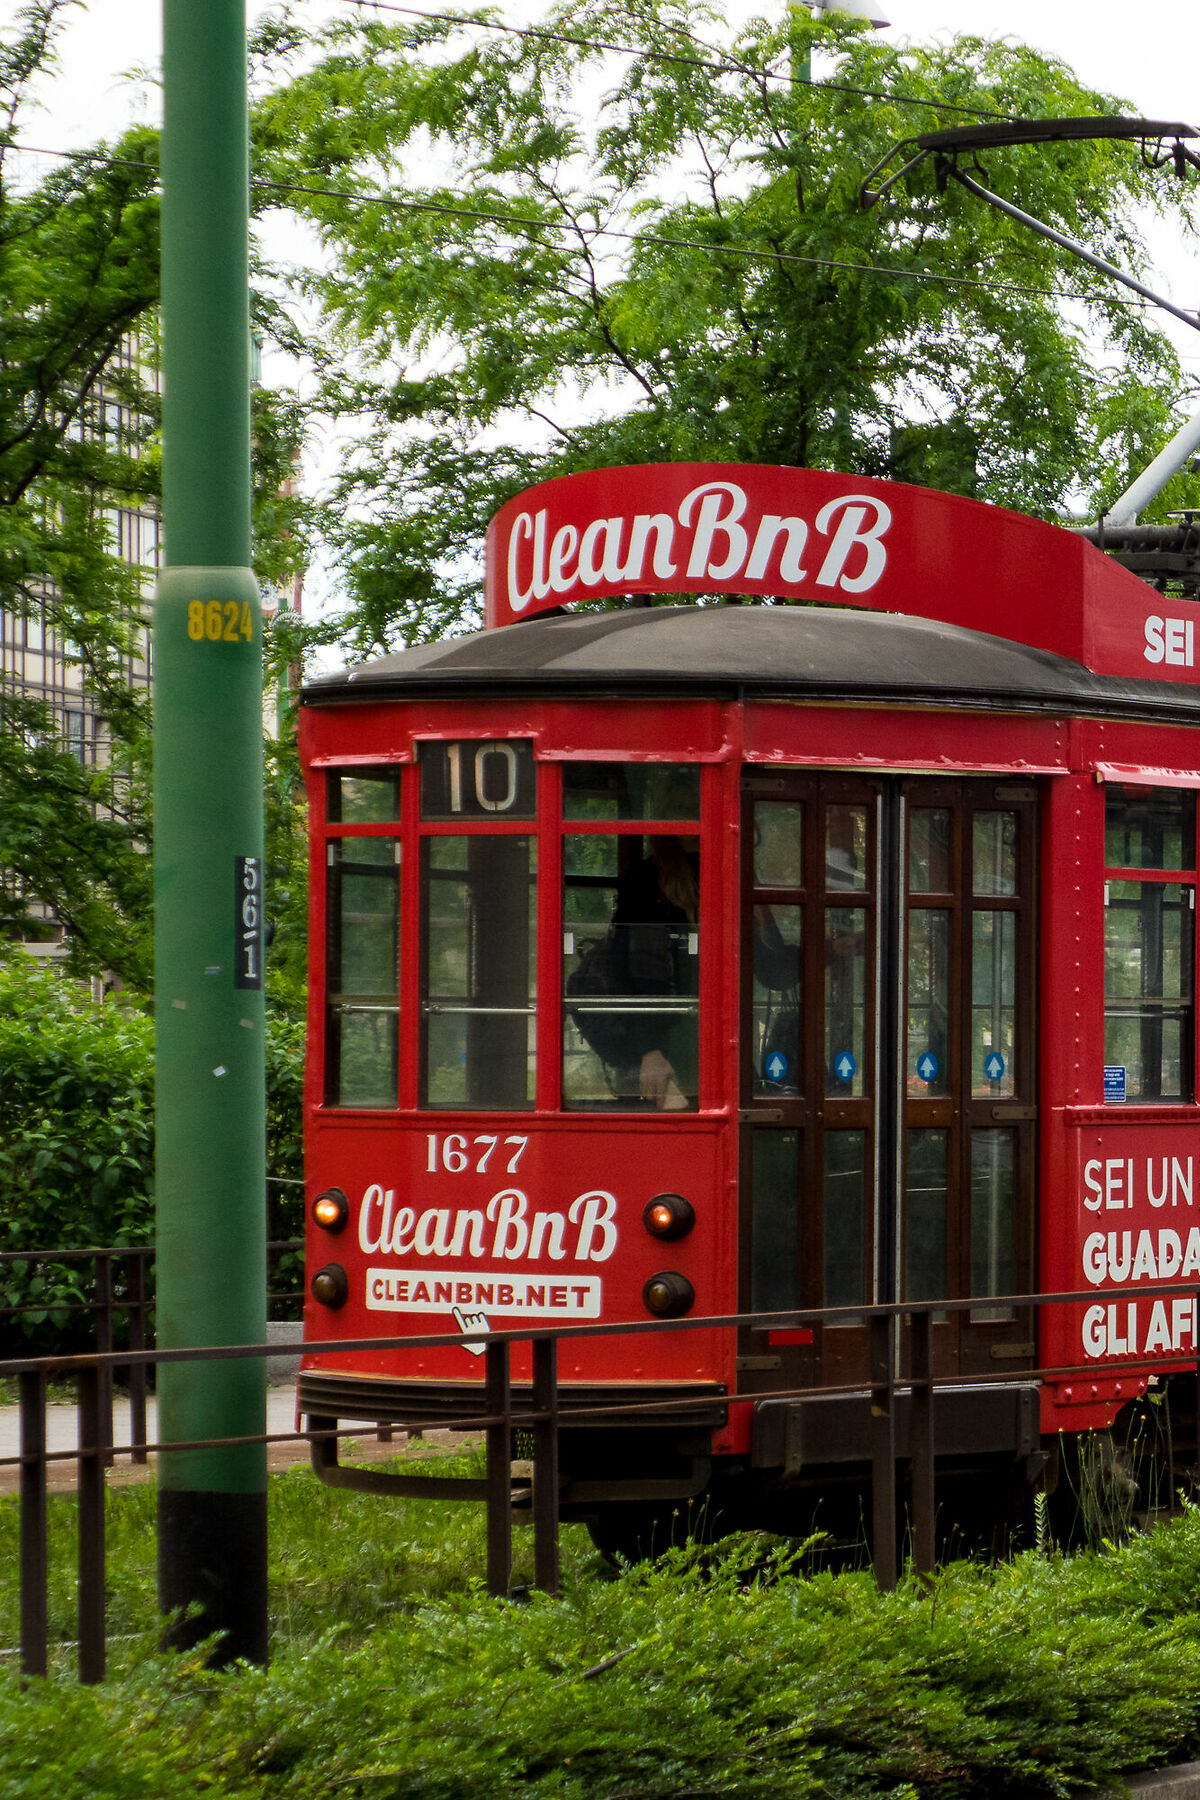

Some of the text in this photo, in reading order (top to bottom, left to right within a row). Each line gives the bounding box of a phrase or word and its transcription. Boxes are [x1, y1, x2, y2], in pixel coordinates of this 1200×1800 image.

[507, 481, 892, 613] CleanBnB
[187, 600, 253, 642] 8624
[1143, 615, 1195, 667] SEI
[447, 743, 517, 812] 10
[426, 1134, 528, 1173] 1677
[1083, 1157, 1134, 1211] SEI
[1147, 1155, 1193, 1208] UN
[358, 1184, 618, 1262] CleanBnB
[372, 1278, 591, 1308] CLEANBNB.NET
[1082, 1302, 1137, 1358] GLI
